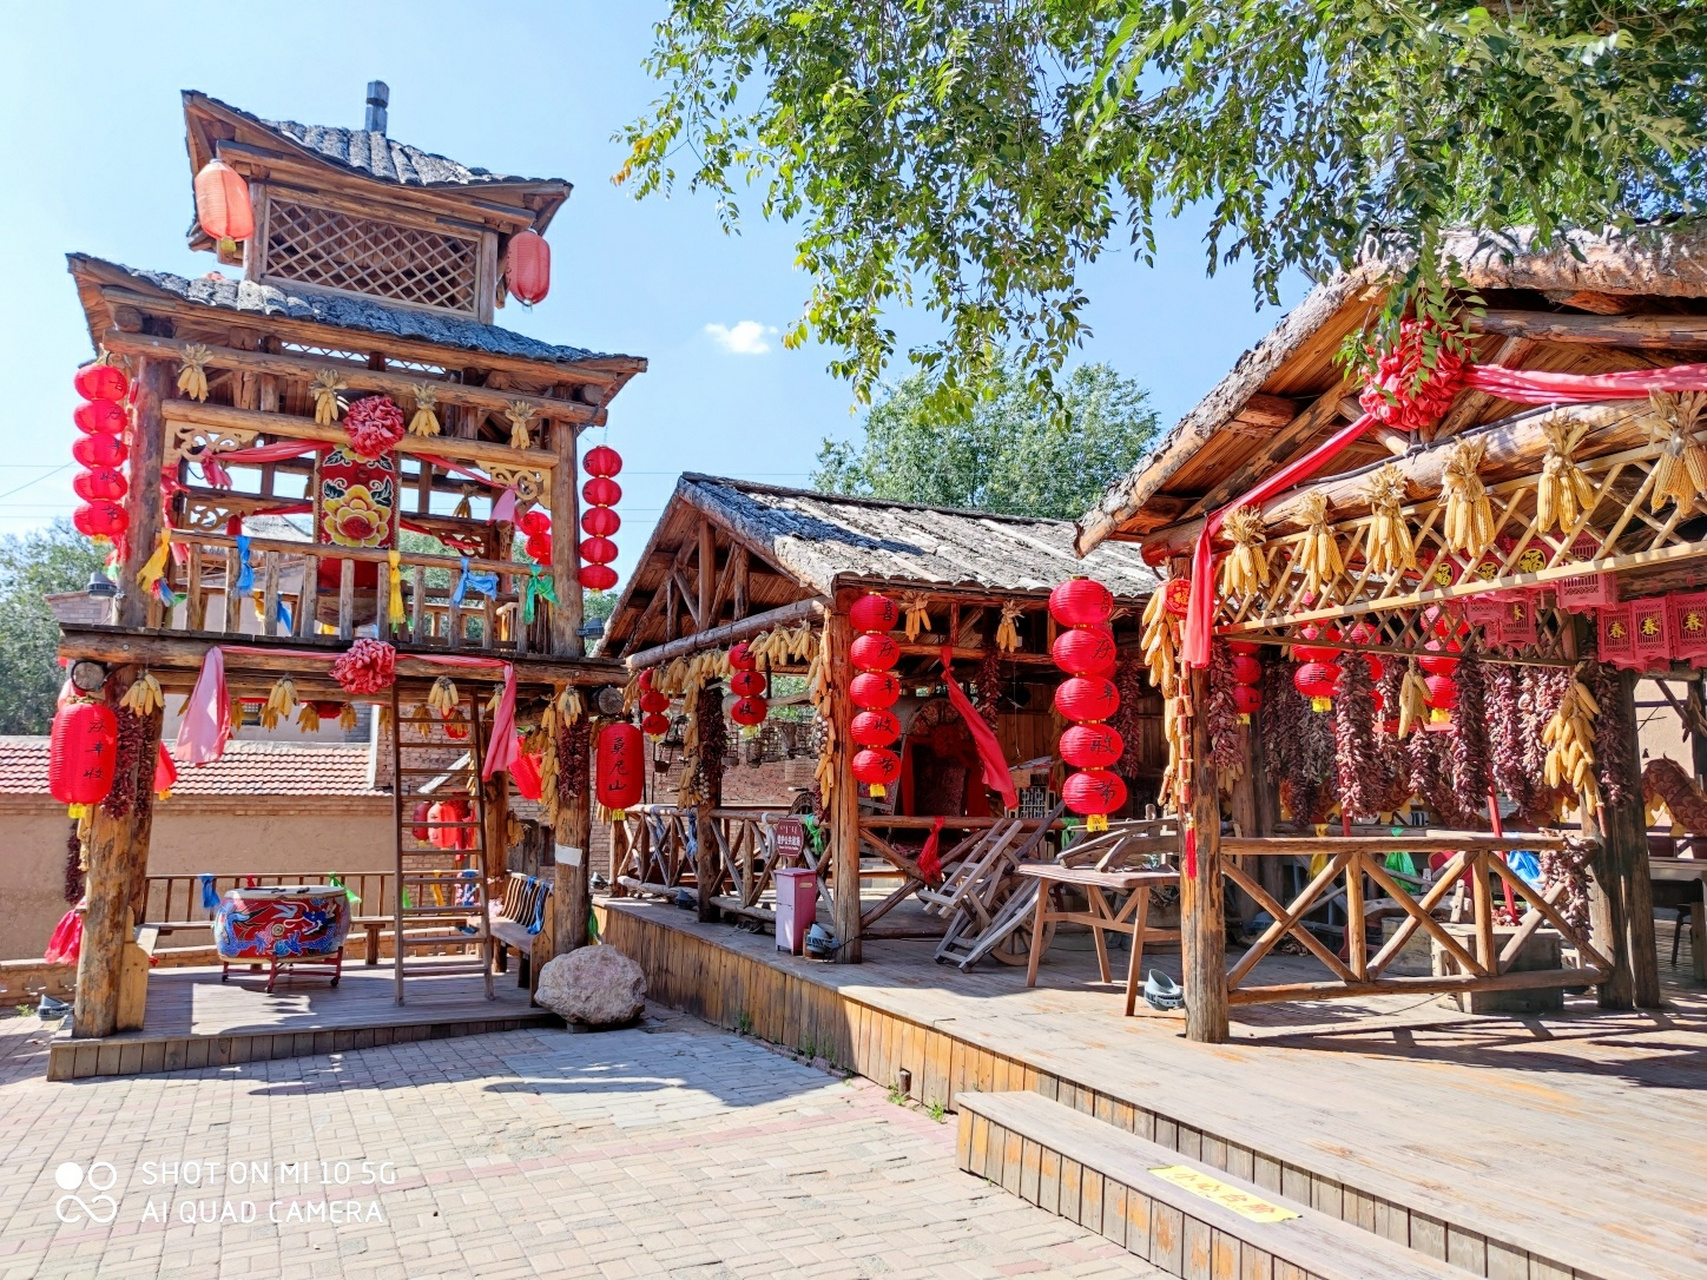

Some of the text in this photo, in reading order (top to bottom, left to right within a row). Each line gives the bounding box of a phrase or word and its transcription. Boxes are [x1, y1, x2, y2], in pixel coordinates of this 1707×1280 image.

[1608, 621, 1626, 638] 春
[1640, 617, 1659, 635] 春
[1684, 612, 1704, 631] 春
[608, 736, 629, 791] 莫尼山
